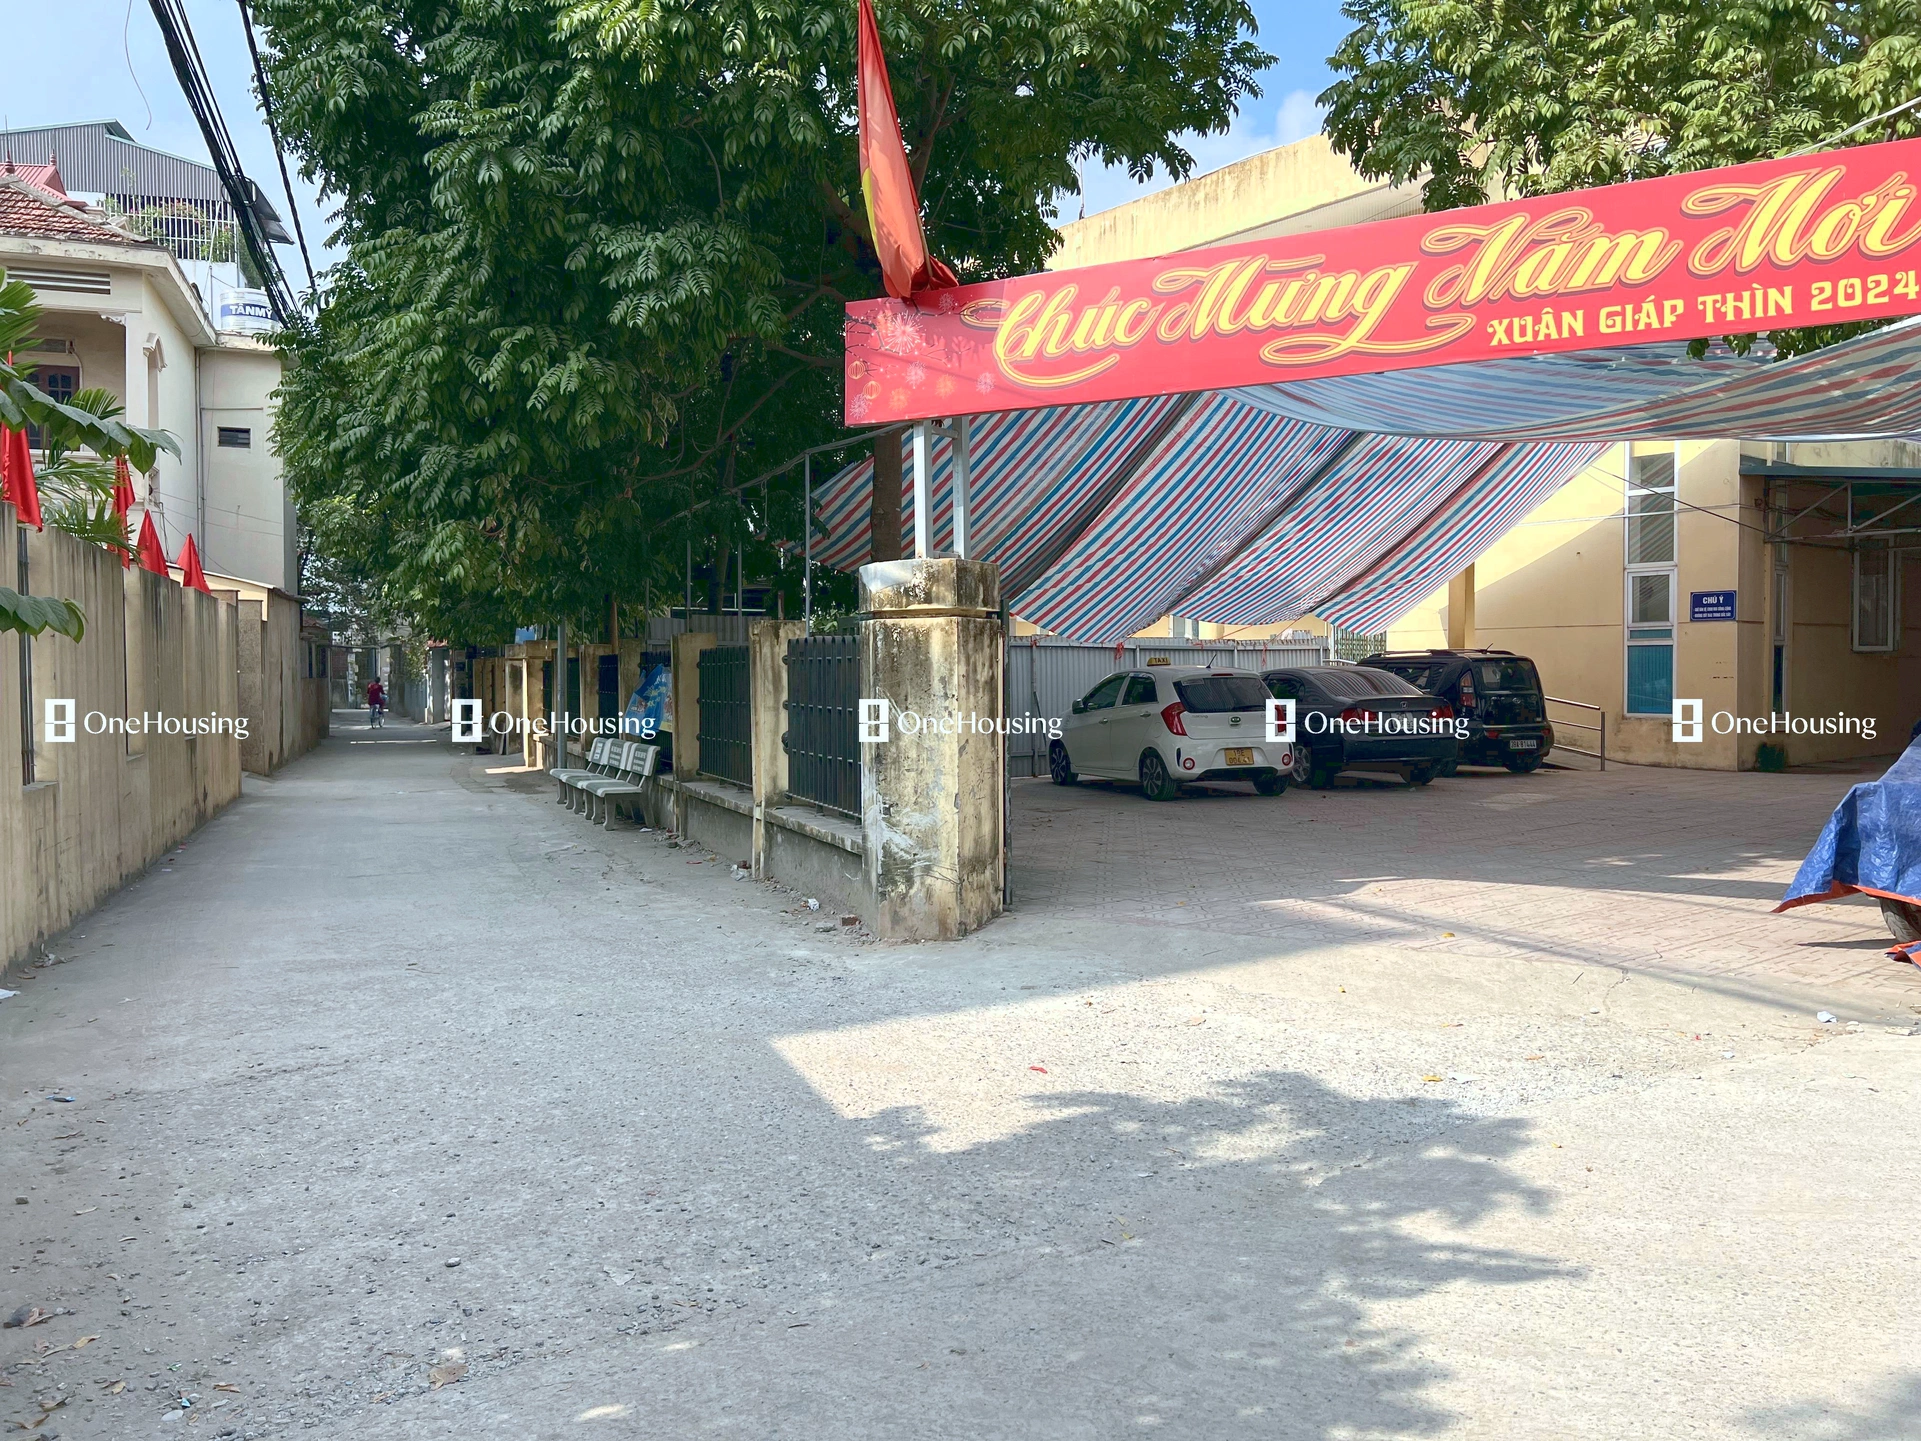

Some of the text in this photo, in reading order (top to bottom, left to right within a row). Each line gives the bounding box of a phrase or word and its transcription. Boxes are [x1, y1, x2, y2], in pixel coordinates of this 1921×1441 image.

[961, 165, 1921, 388] Chúc Mừng Năm Mới
[1487, 269, 1920, 347] XUÂN GIÁP THÌN 2024
